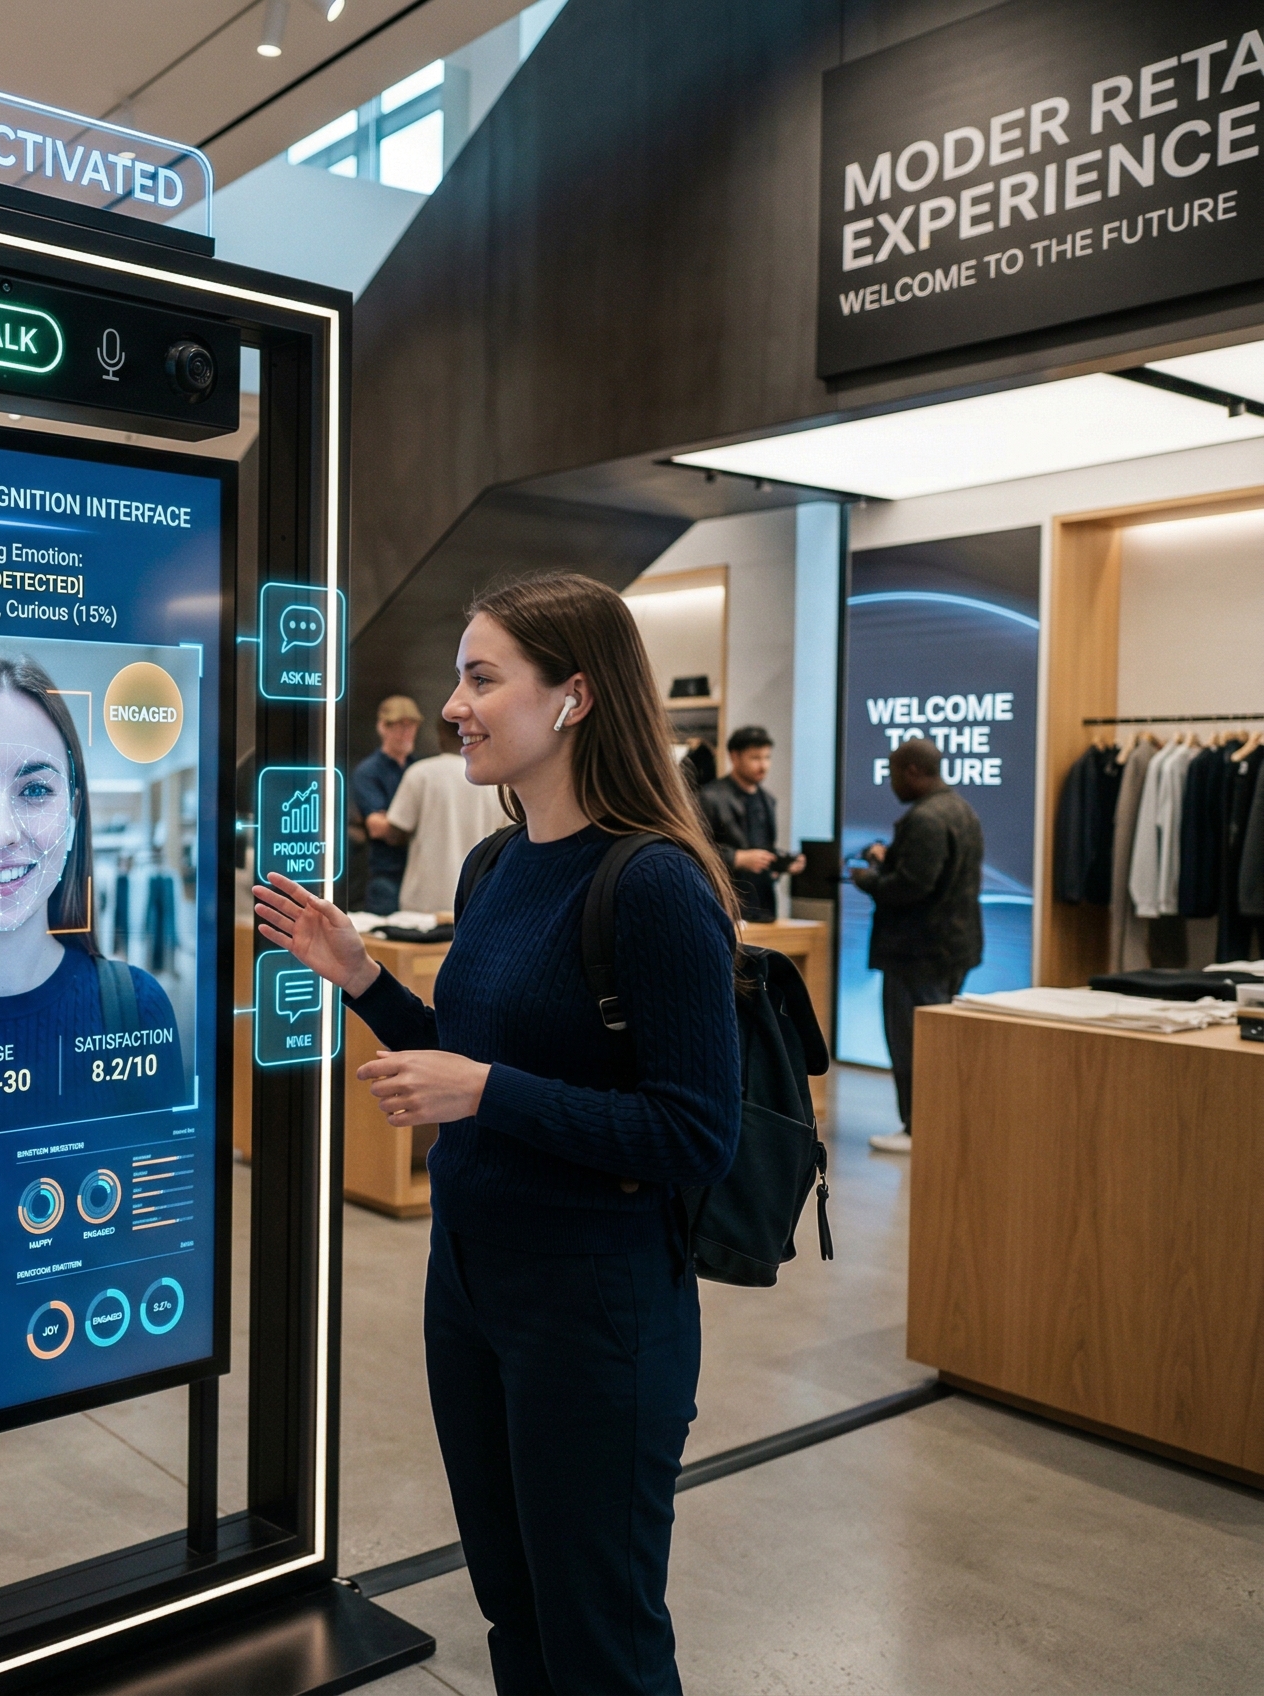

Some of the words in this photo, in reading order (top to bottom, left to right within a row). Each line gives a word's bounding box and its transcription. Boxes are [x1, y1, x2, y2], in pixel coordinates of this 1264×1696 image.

[844, 95, 1070, 213] MODER
[842, 100, 1261, 272] EXPERIENCE
[839, 258, 978, 316] WELCOME
[983, 247, 1024, 279] TO
[1030, 227, 1093, 267] THE
[1102, 189, 1238, 250] FUTURE
[86, 496, 191, 529] INTERFACE
[12, 543, 83, 568] Emotion:
[6, 600, 69, 622] Curious
[73, 604, 118, 629] (15%)
[280, 670, 303, 685] ASK
[305, 672, 322, 686] ME
[109, 705, 178, 724] ENGAGED
[866, 692, 1014, 725] WELCOME
[929, 725, 991, 754] THE
[873, 757, 1003, 786] FURE
[273, 841, 327, 856] PRODUCT
[286, 858, 315, 873] INFO
[74, 1027, 174, 1053] SATISFACTION
[91, 1054, 158, 1083] 8.2/10
[42, 1324, 59, 1337] JOY
